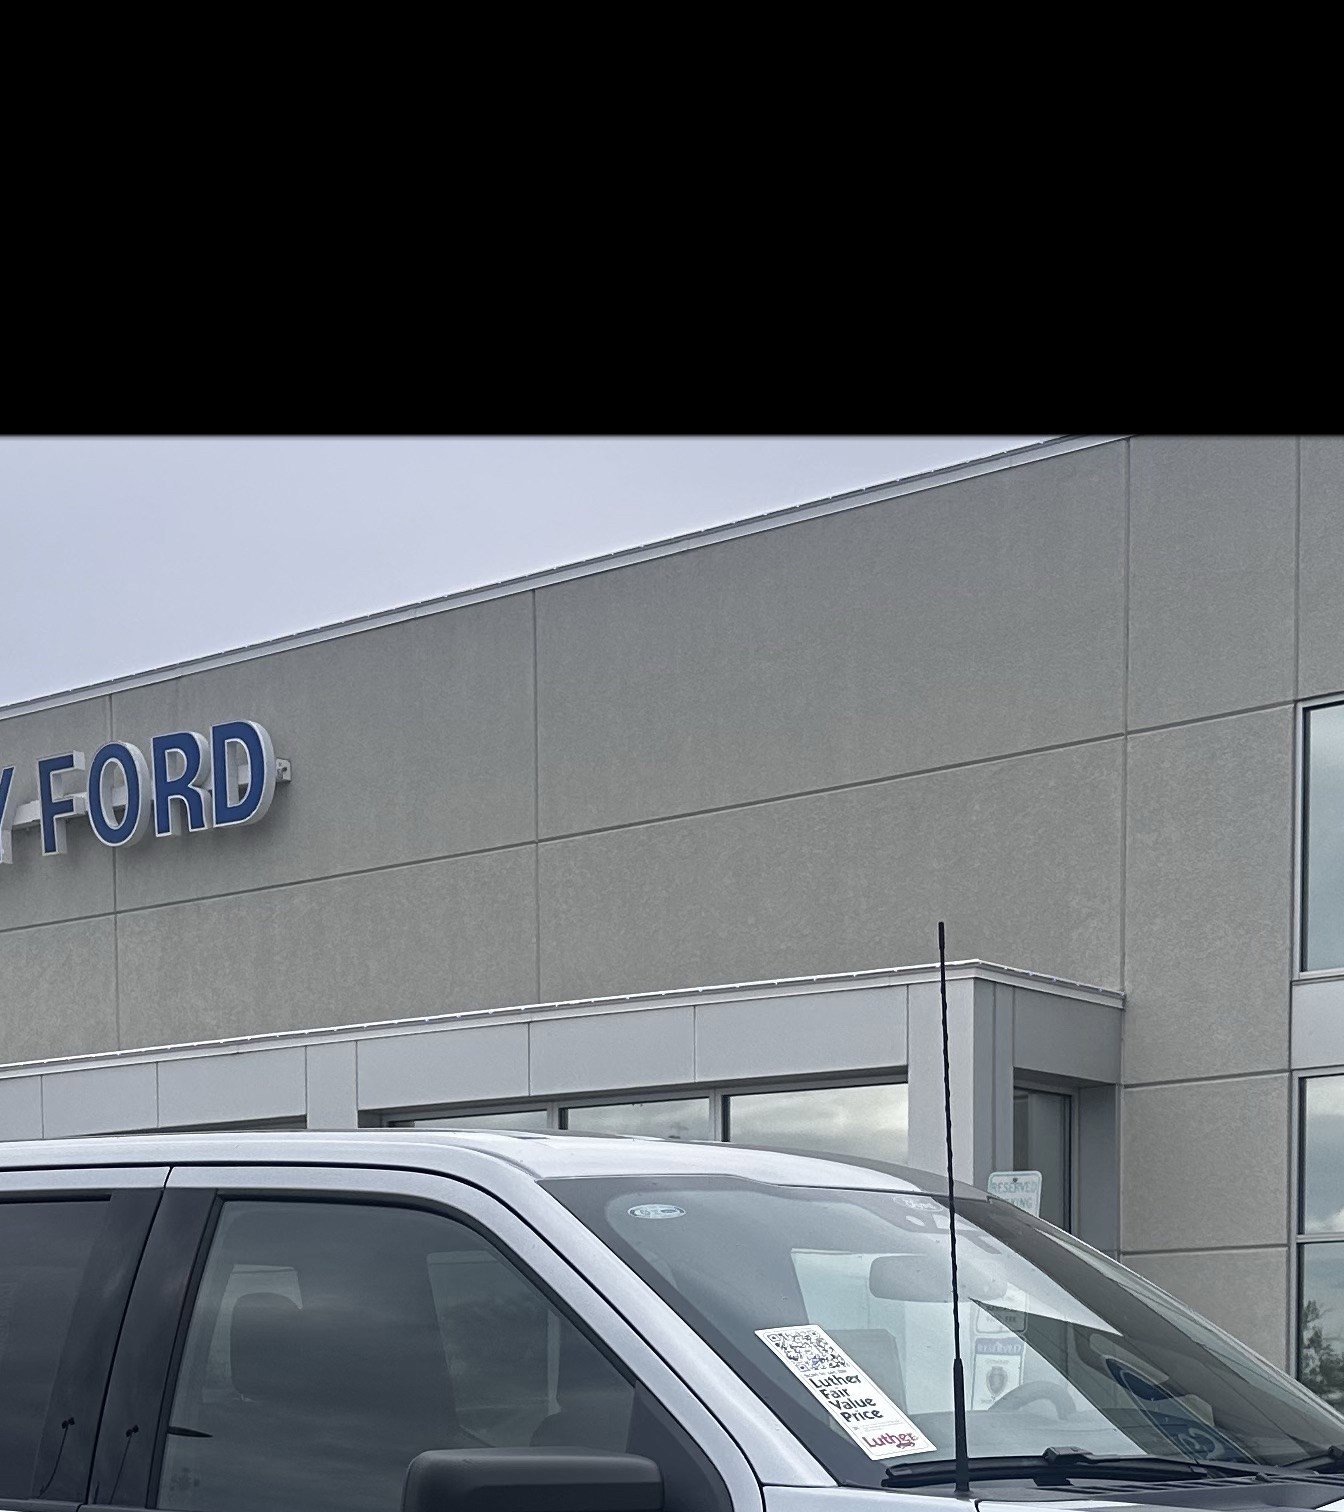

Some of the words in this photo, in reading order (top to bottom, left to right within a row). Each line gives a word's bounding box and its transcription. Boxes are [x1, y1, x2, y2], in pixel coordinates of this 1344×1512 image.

[36, 719, 275, 856] FORD
[809, 1374, 862, 1389] Luther
[819, 1388, 851, 1400] Fair
[828, 1397, 877, 1411] Value
[840, 1409, 884, 1423] Price
[862, 1432, 915, 1448] Luther
